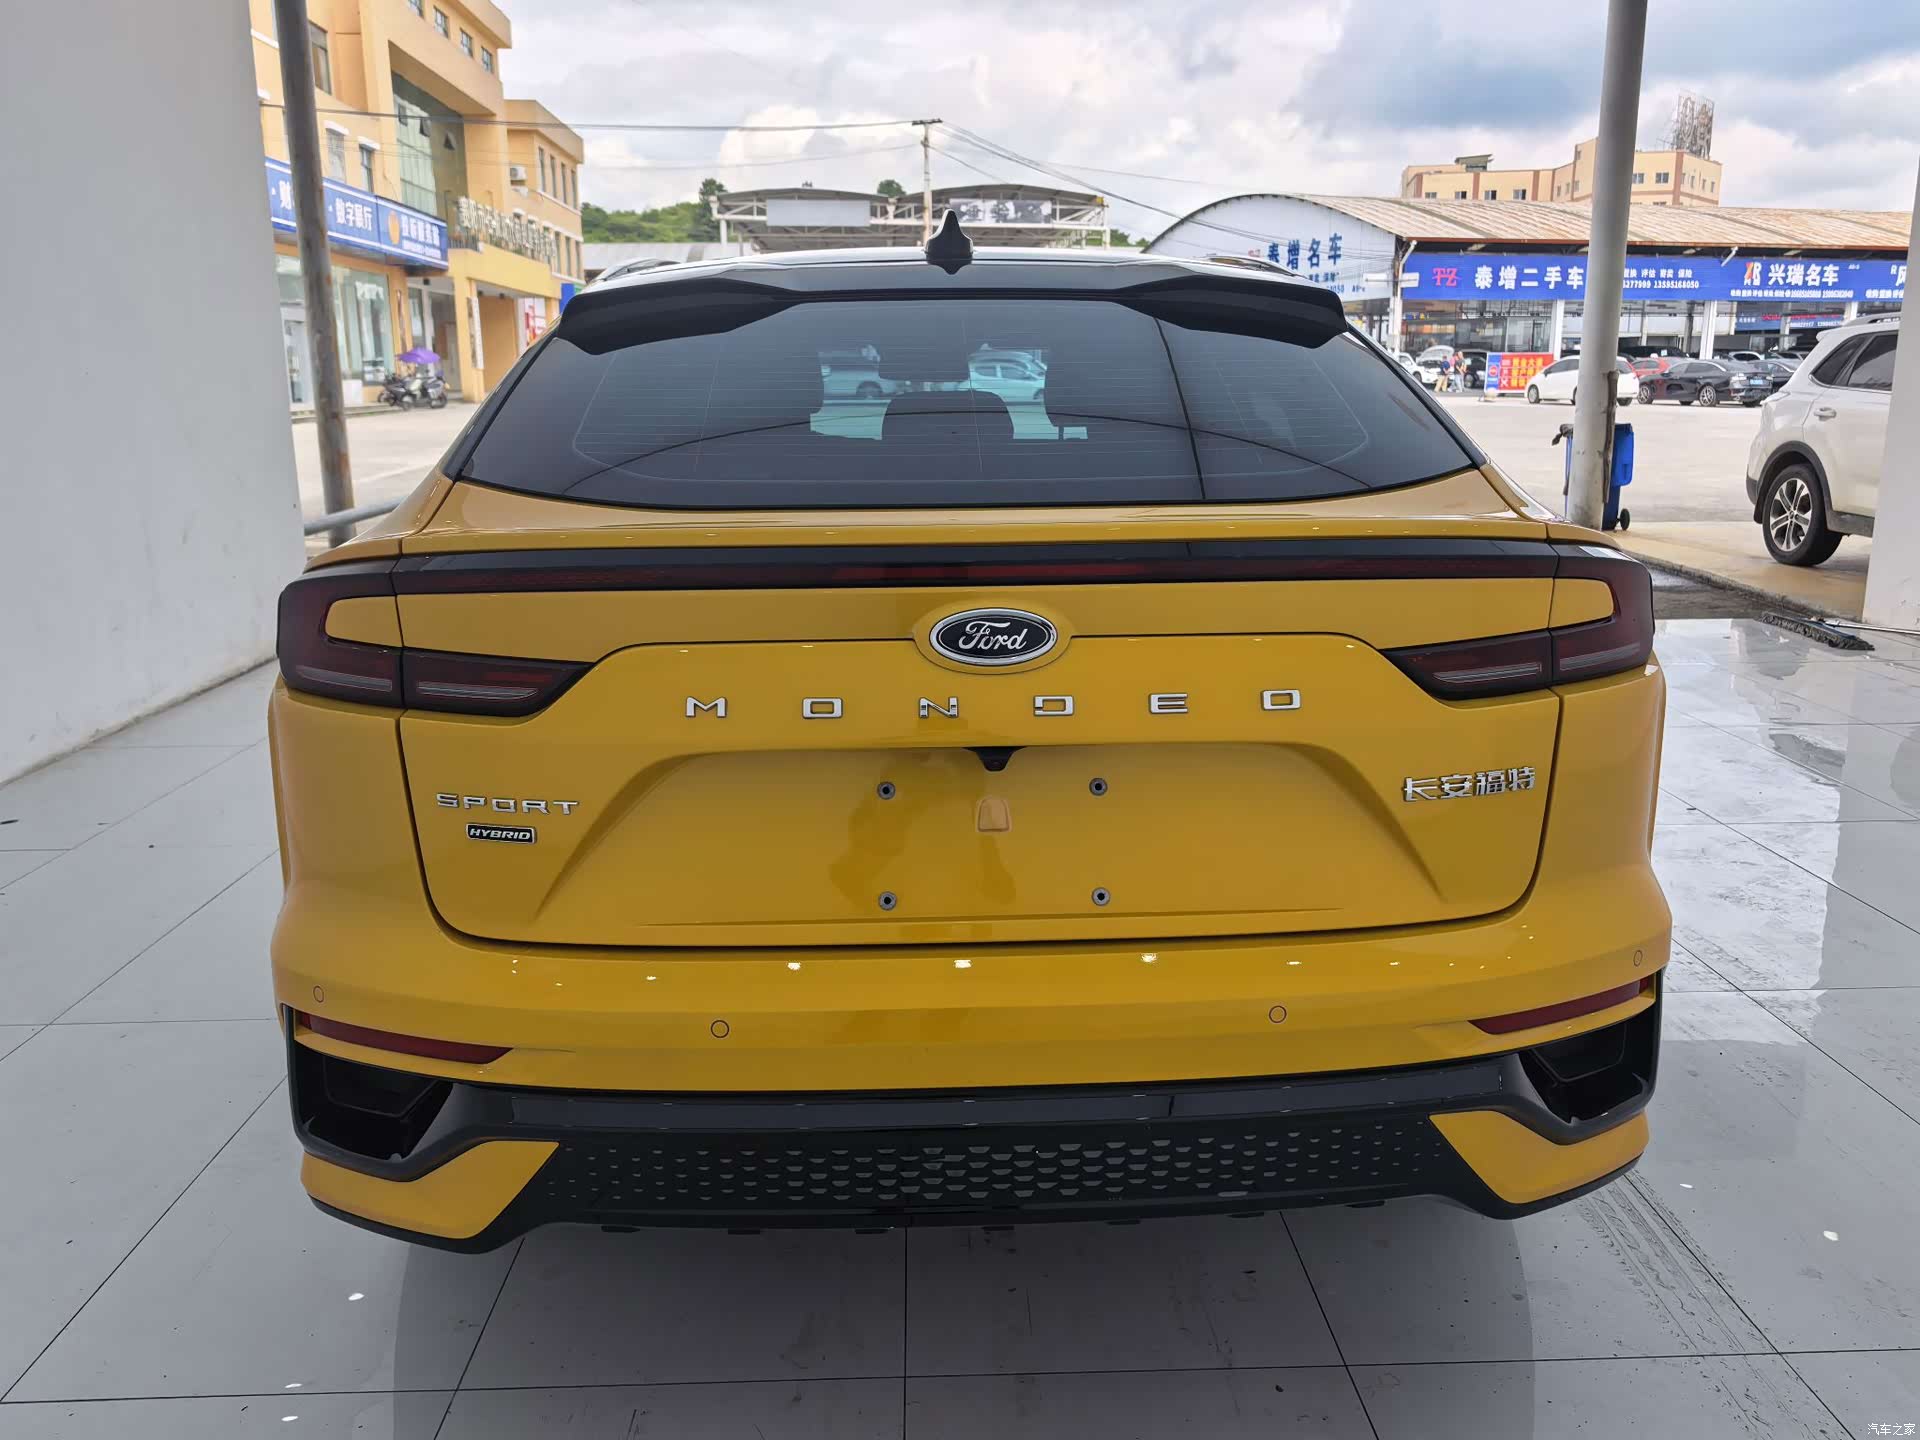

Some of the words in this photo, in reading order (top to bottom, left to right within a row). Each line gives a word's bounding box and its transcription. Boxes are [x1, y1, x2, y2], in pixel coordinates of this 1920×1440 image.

[1267, 232, 1343, 271] 泰增名车
[1474, 264, 1585, 290] 泰增二手车
[1768, 263, 1840, 287] 兴瑞名车
[958, 620, 1029, 651] Ford
[685, 689, 1301, 719] MONDEO
[1403, 766, 1536, 802] 长安福特
[436, 793, 579, 816] SPORT
[469, 828, 531, 841] HYBRID
